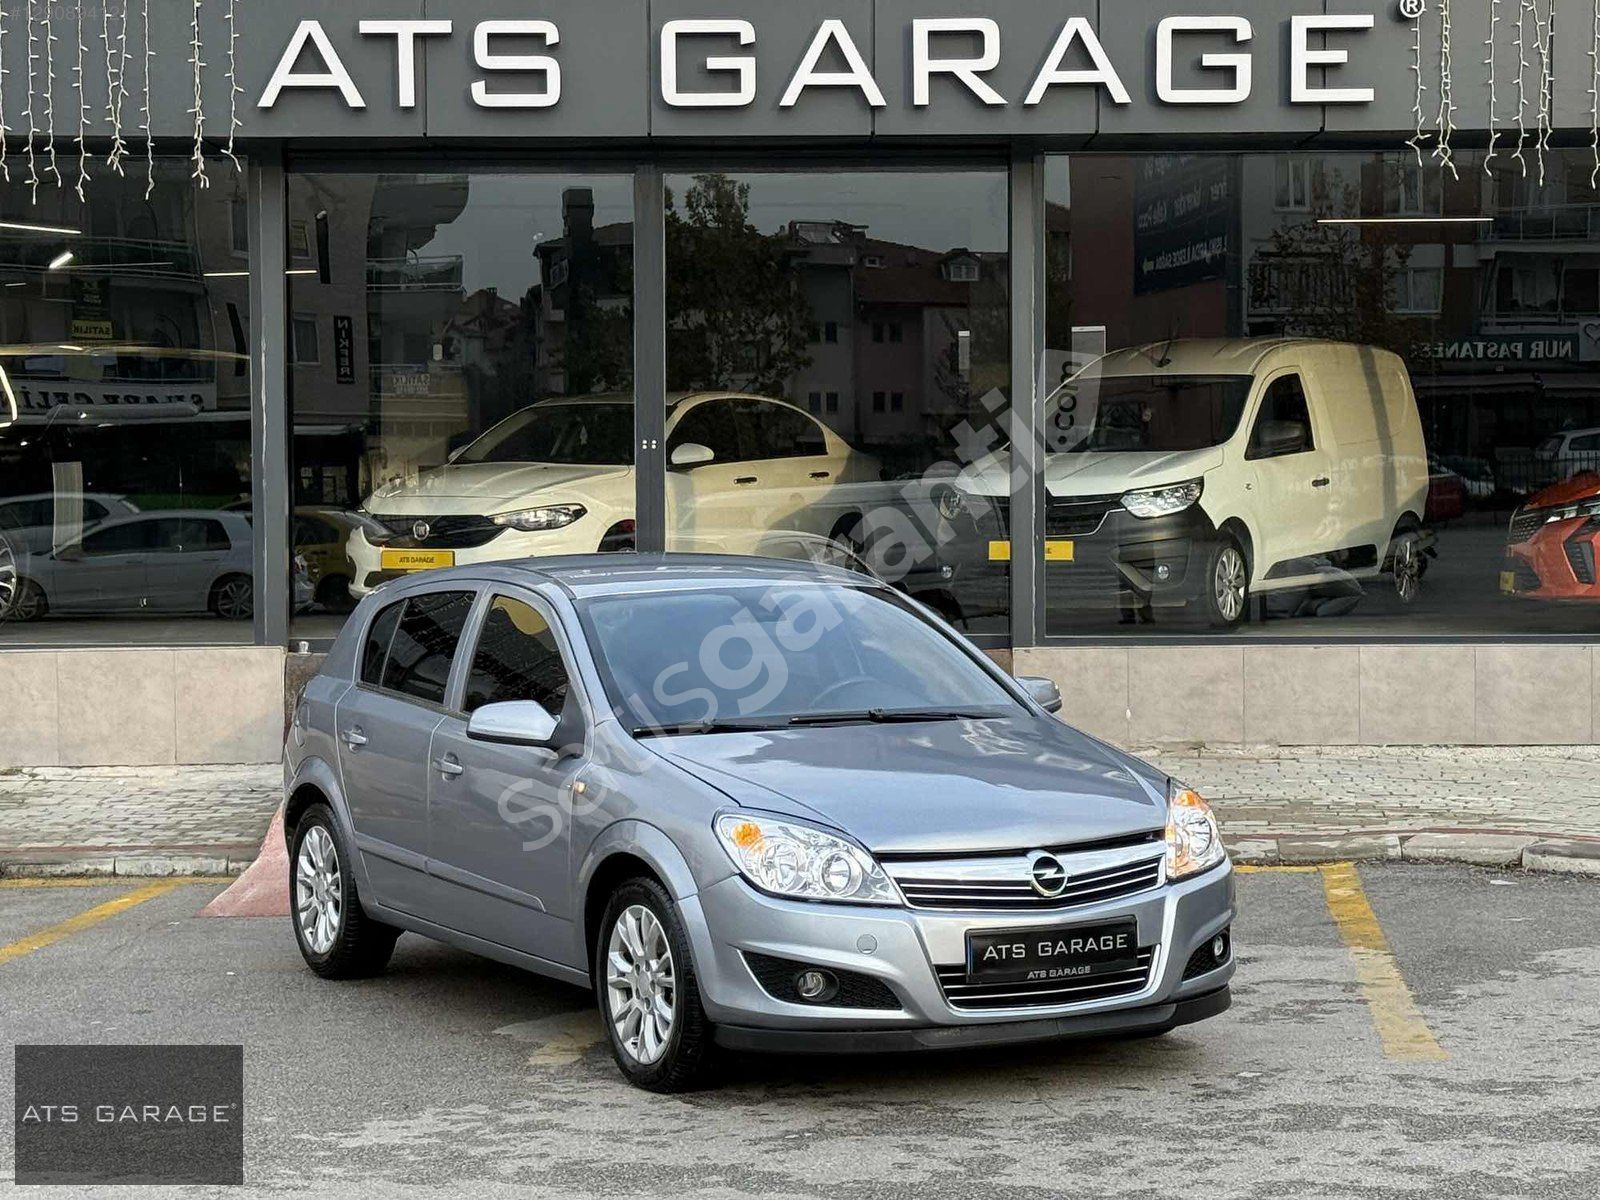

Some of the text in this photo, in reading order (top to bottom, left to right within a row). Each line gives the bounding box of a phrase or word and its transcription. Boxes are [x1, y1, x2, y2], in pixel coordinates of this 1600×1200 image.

[257, 19, 562, 108] ATS
[660, 14, 1375, 107] GARAGE
[983, 933, 1129, 961] ATS GARAGE
[1027, 965, 1092, 980] ATS GARAGE
